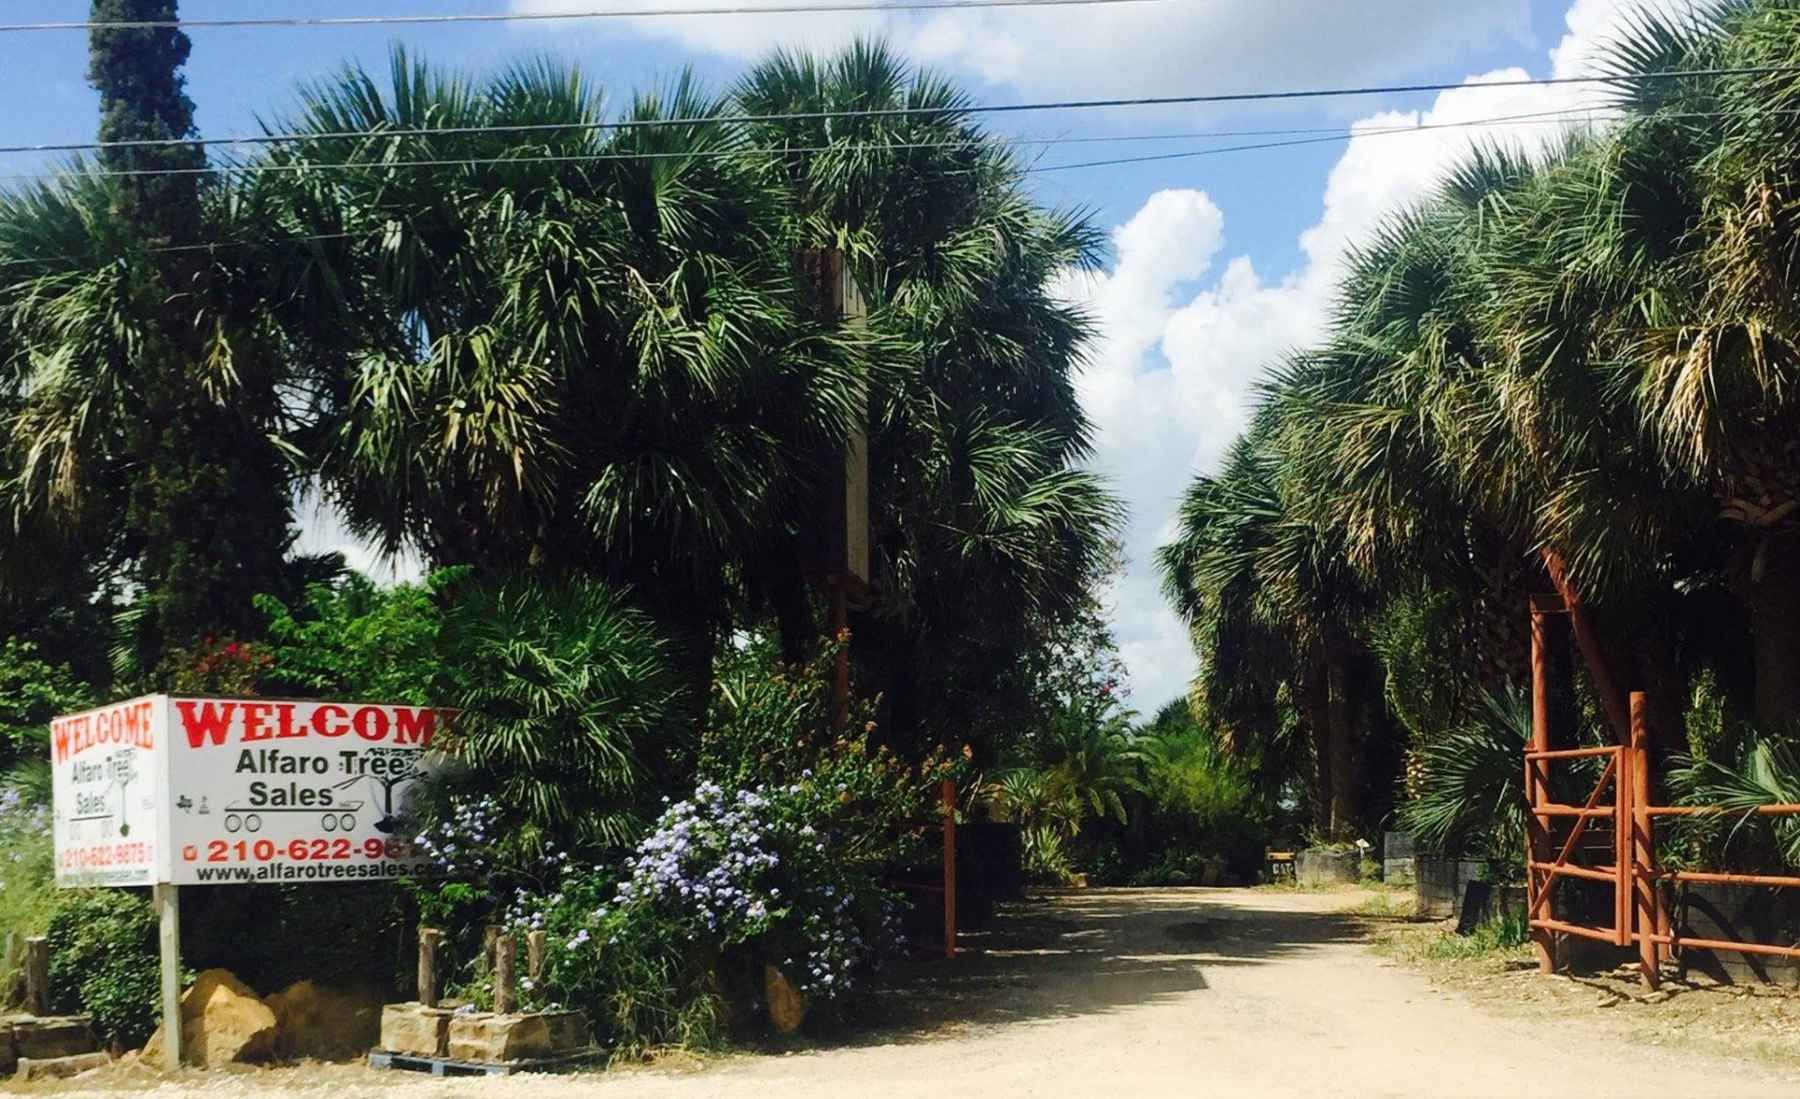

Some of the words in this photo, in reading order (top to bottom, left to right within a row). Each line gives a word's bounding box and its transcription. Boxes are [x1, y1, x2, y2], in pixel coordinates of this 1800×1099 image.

[54, 702, 153, 765] WELCOME
[73, 760, 103, 784] Alfaro
[235, 749, 328, 774] Alfaro
[340, 750, 404, 775] Tree
[77, 791, 105, 815] Sales
[249, 781, 334, 806] Sales
